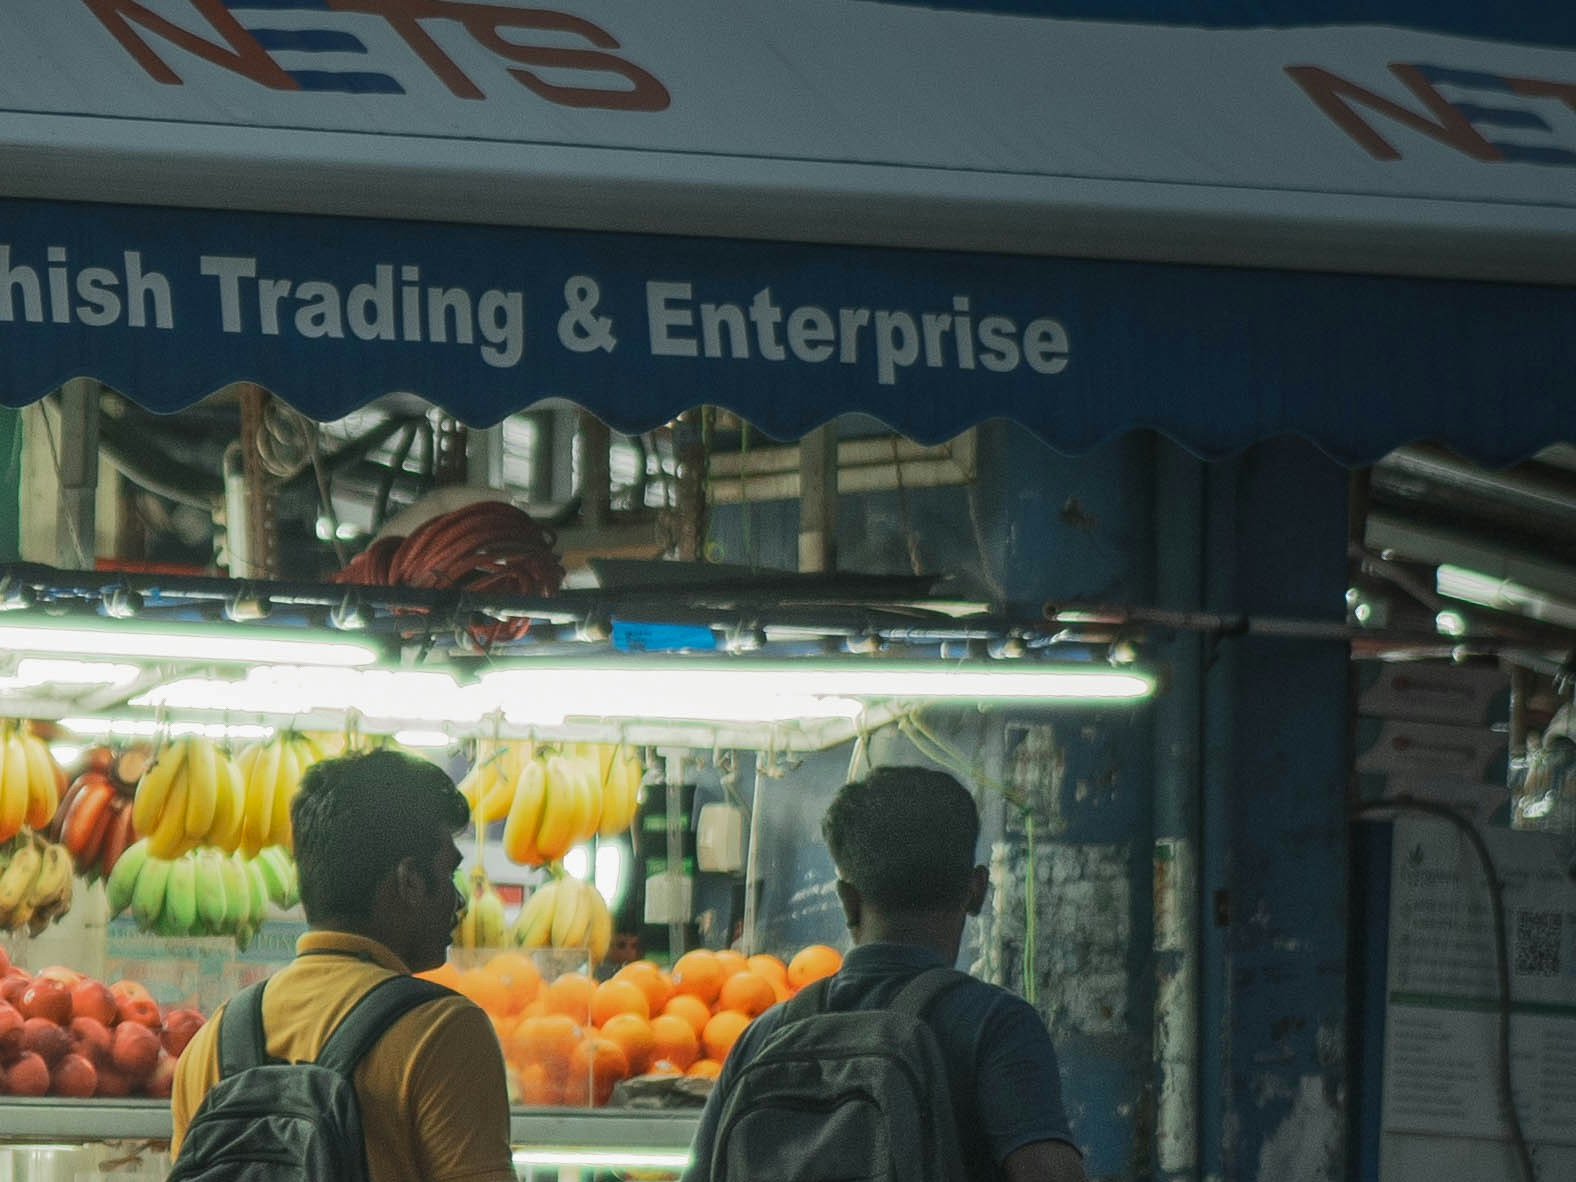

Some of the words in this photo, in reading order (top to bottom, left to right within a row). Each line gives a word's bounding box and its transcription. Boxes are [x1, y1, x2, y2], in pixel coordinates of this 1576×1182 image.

[83, 0, 671, 112] NETS
[200, 256, 524, 368] Trading
[558, 276, 617, 353] &
[646, 281, 1069, 385] Enterprise
